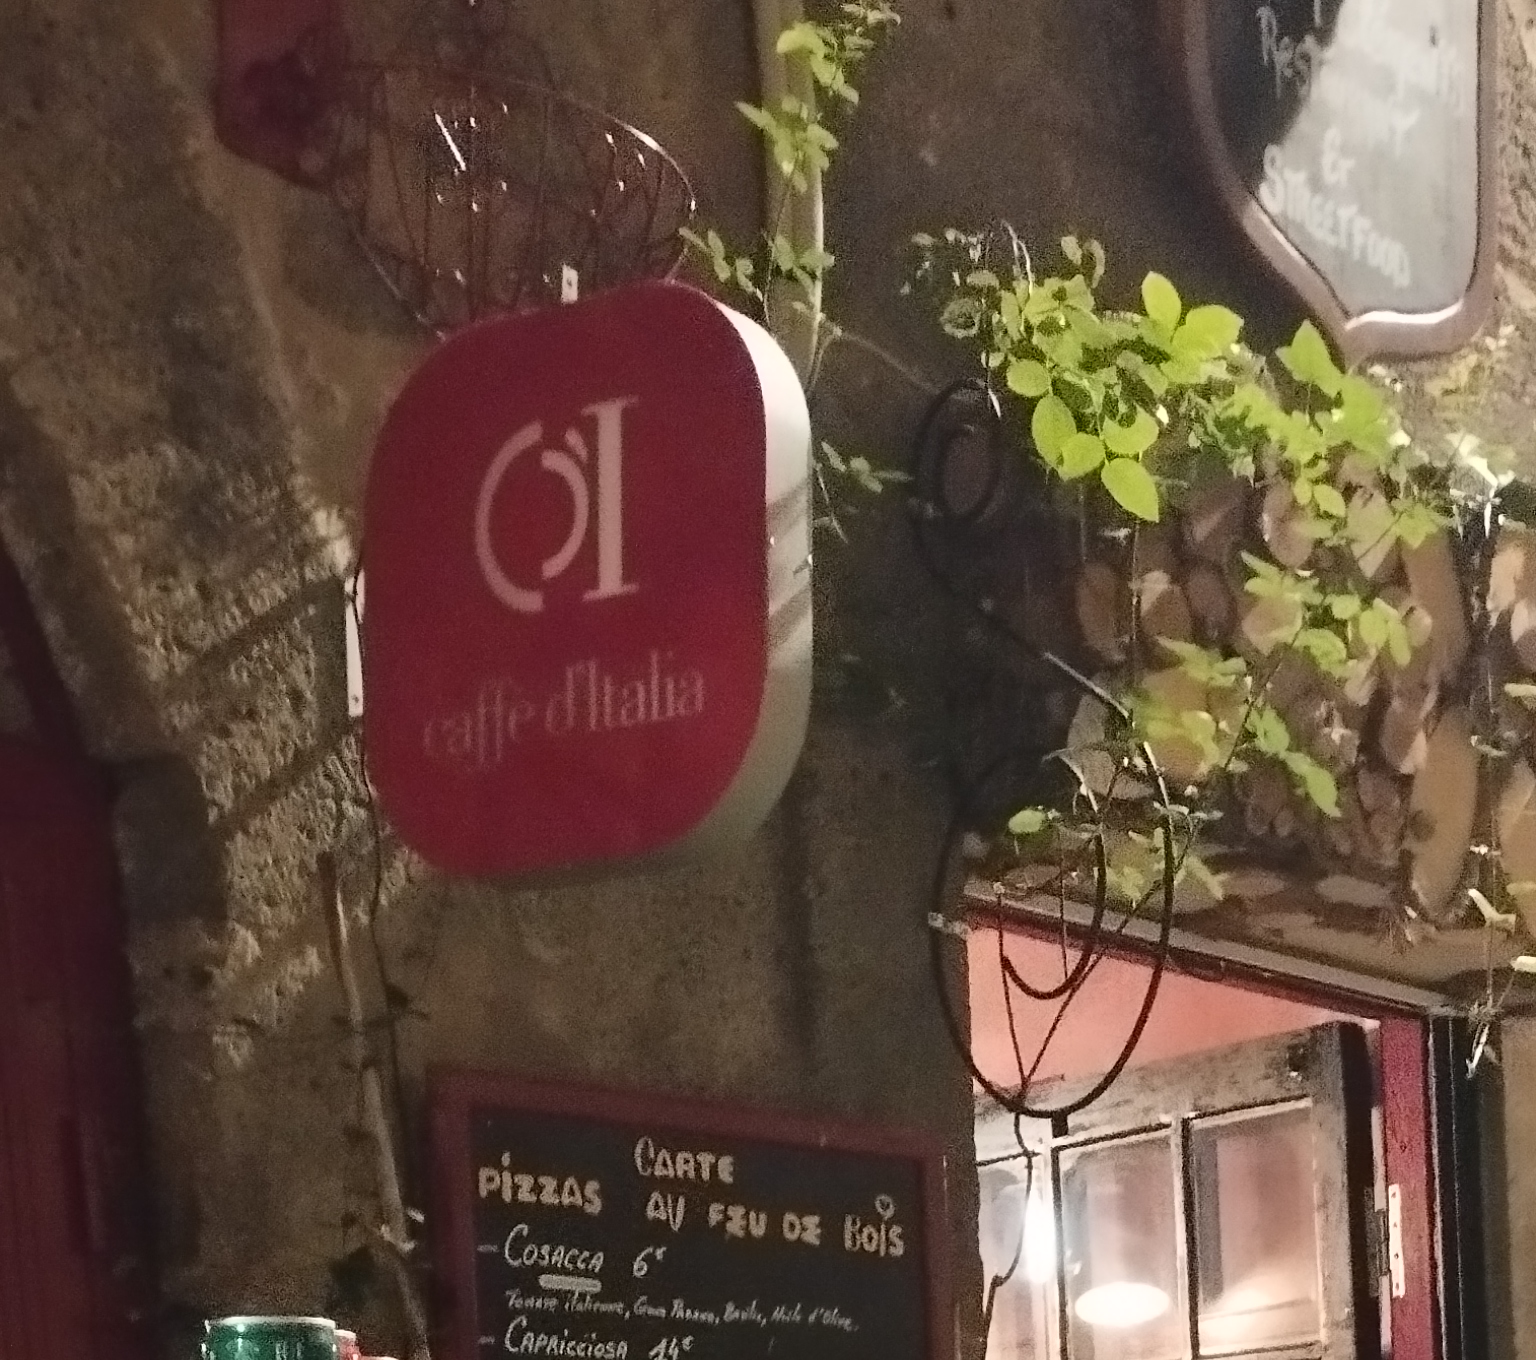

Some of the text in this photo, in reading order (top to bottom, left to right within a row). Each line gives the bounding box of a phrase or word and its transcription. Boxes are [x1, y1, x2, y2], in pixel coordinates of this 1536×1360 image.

[634, 1136, 735, 1185] CARTE
[478, 1151, 602, 1215] PIZZAS
[646, 1190, 685, 1232] AU
[708, 1202, 768, 1240] FEU
[782, 1211, 822, 1246] DE
